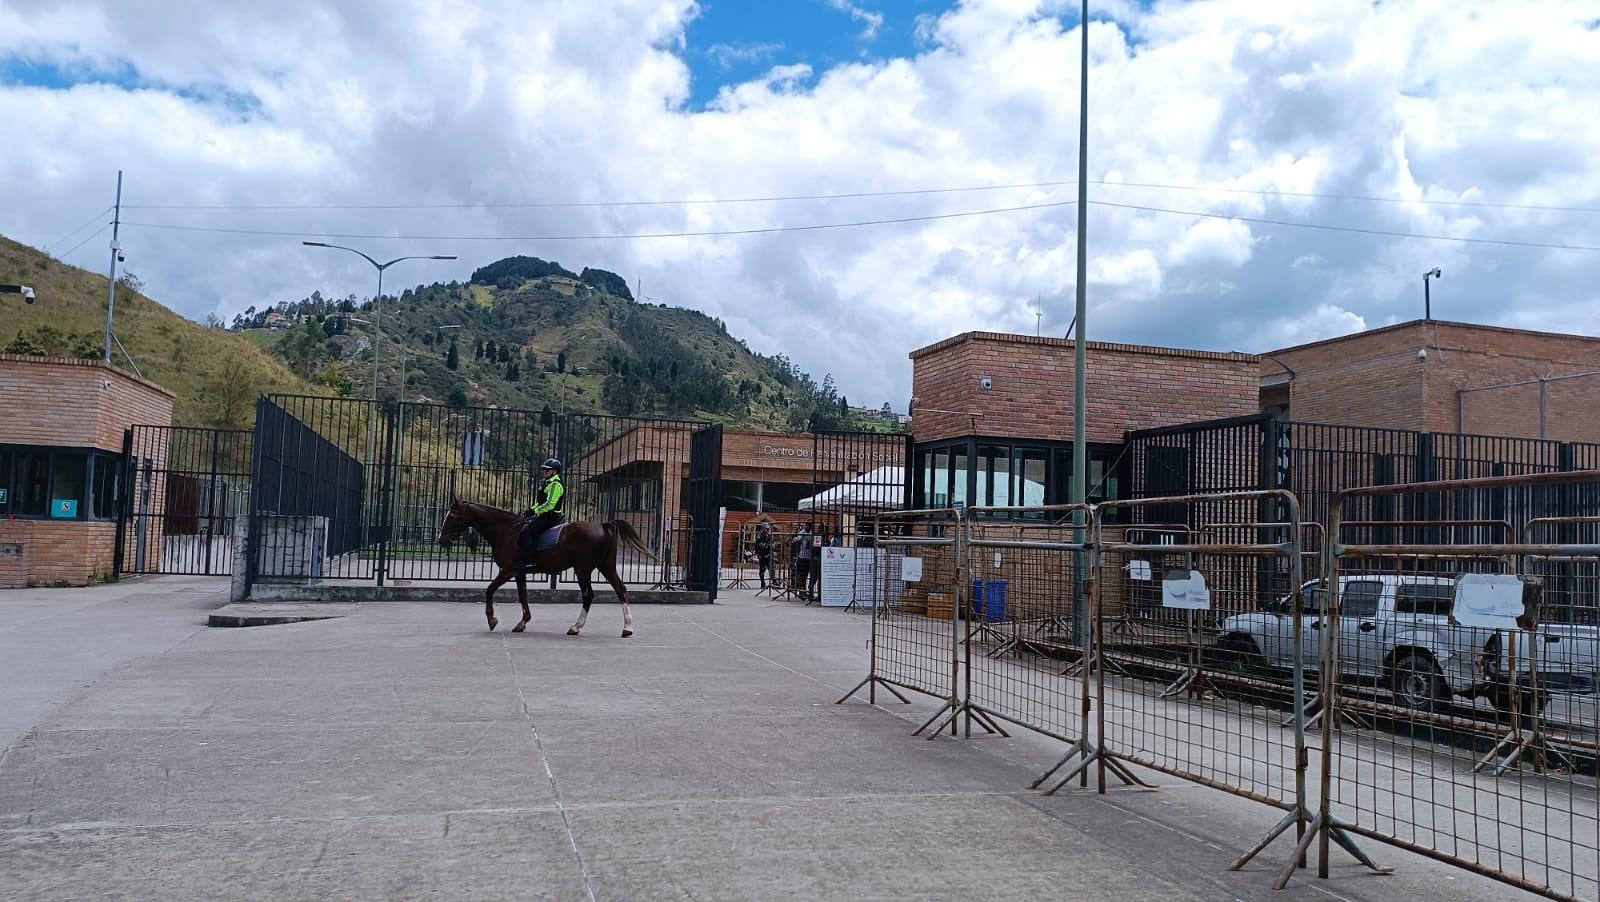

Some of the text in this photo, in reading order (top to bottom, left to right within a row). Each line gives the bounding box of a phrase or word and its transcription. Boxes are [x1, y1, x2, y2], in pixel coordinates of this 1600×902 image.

[764, 445, 898, 462] Centro de Rehabiltacón Socal
